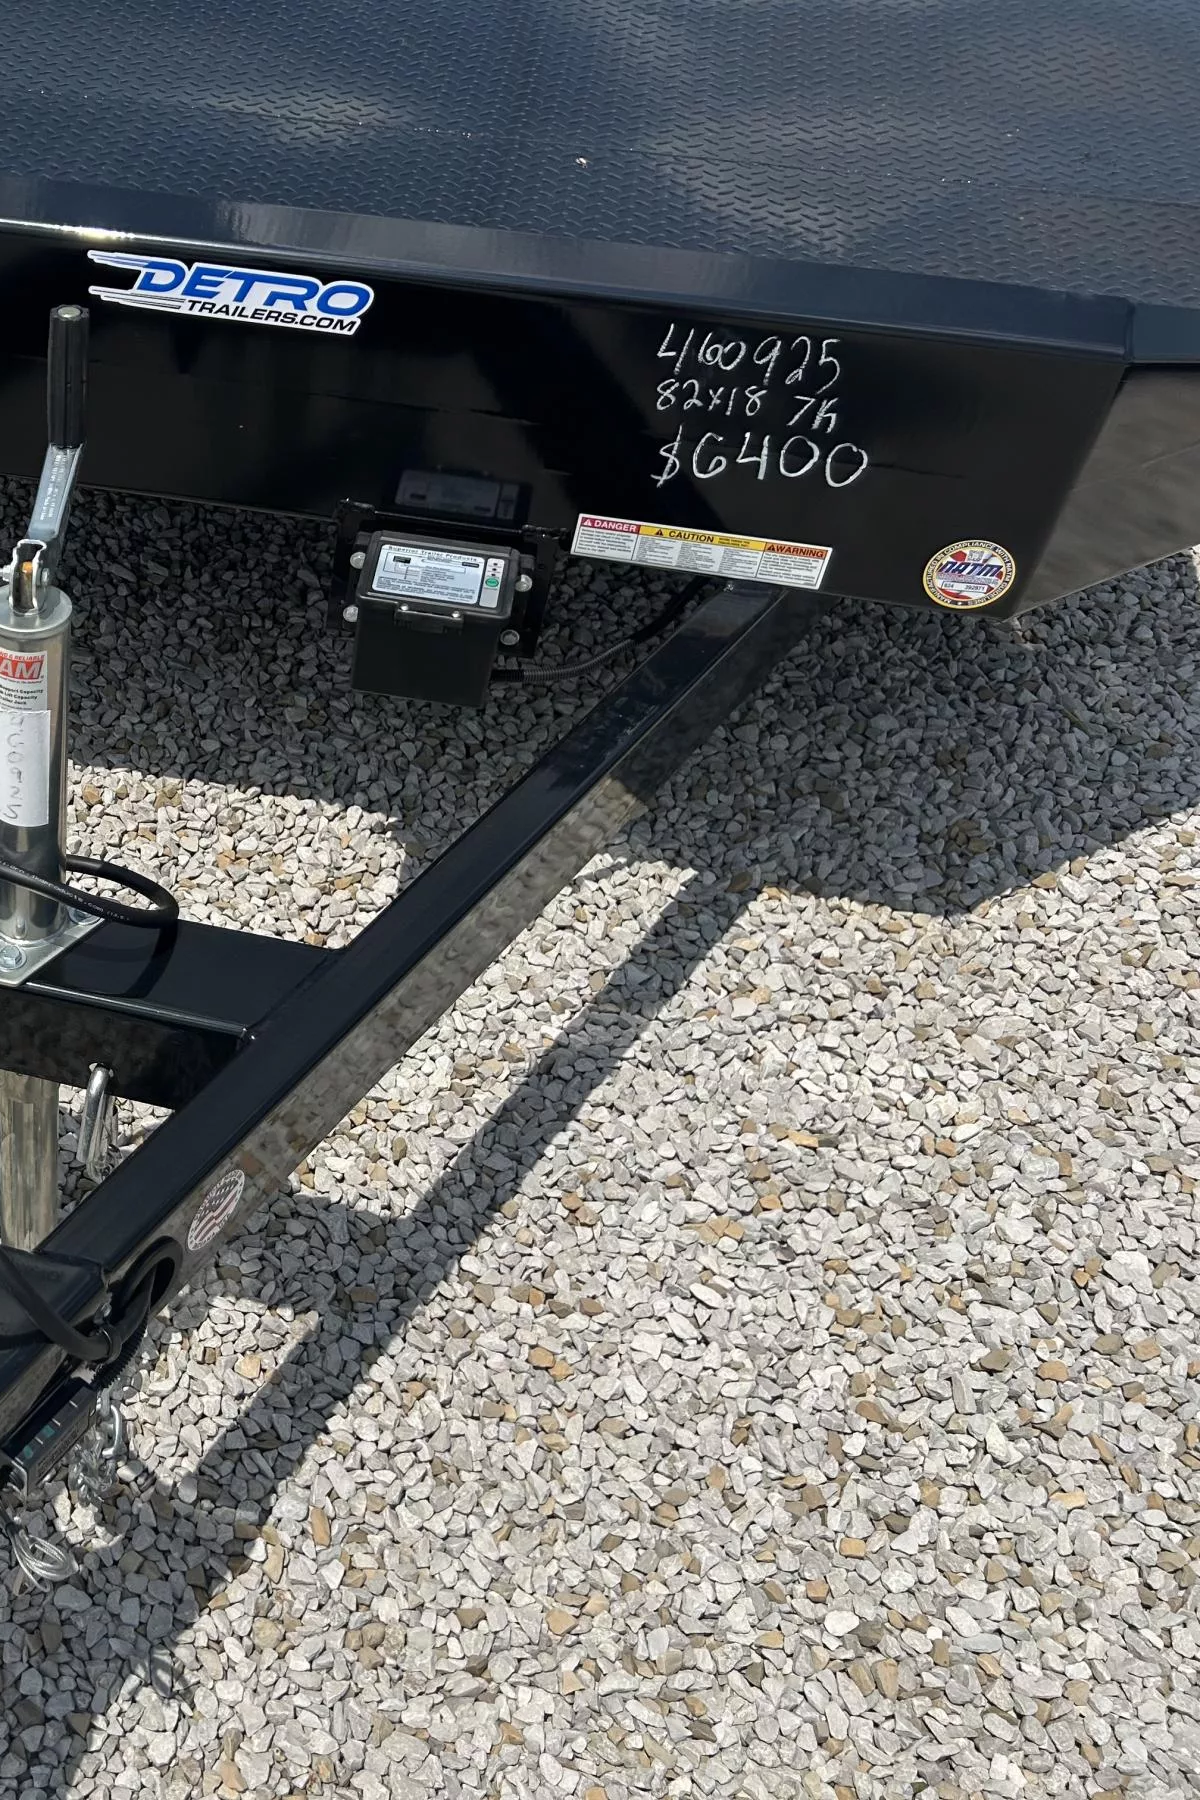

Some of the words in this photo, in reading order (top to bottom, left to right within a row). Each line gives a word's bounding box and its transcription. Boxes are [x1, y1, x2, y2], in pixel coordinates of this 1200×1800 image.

[137, 261, 370, 317] DETRO
[187, 299, 357, 333] TRAILERS.COM
[650, 424, 869, 488] $6400
[594, 519, 637, 533] DANGER
[668, 530, 714, 543] CAUTION
[388, 545, 419, 555] Superior
[421, 549, 442, 557] Trailer
[445, 553, 477, 562] Products
[776, 544, 825, 558] WARNING
[944, 541, 996, 555] COMPLIANCE
